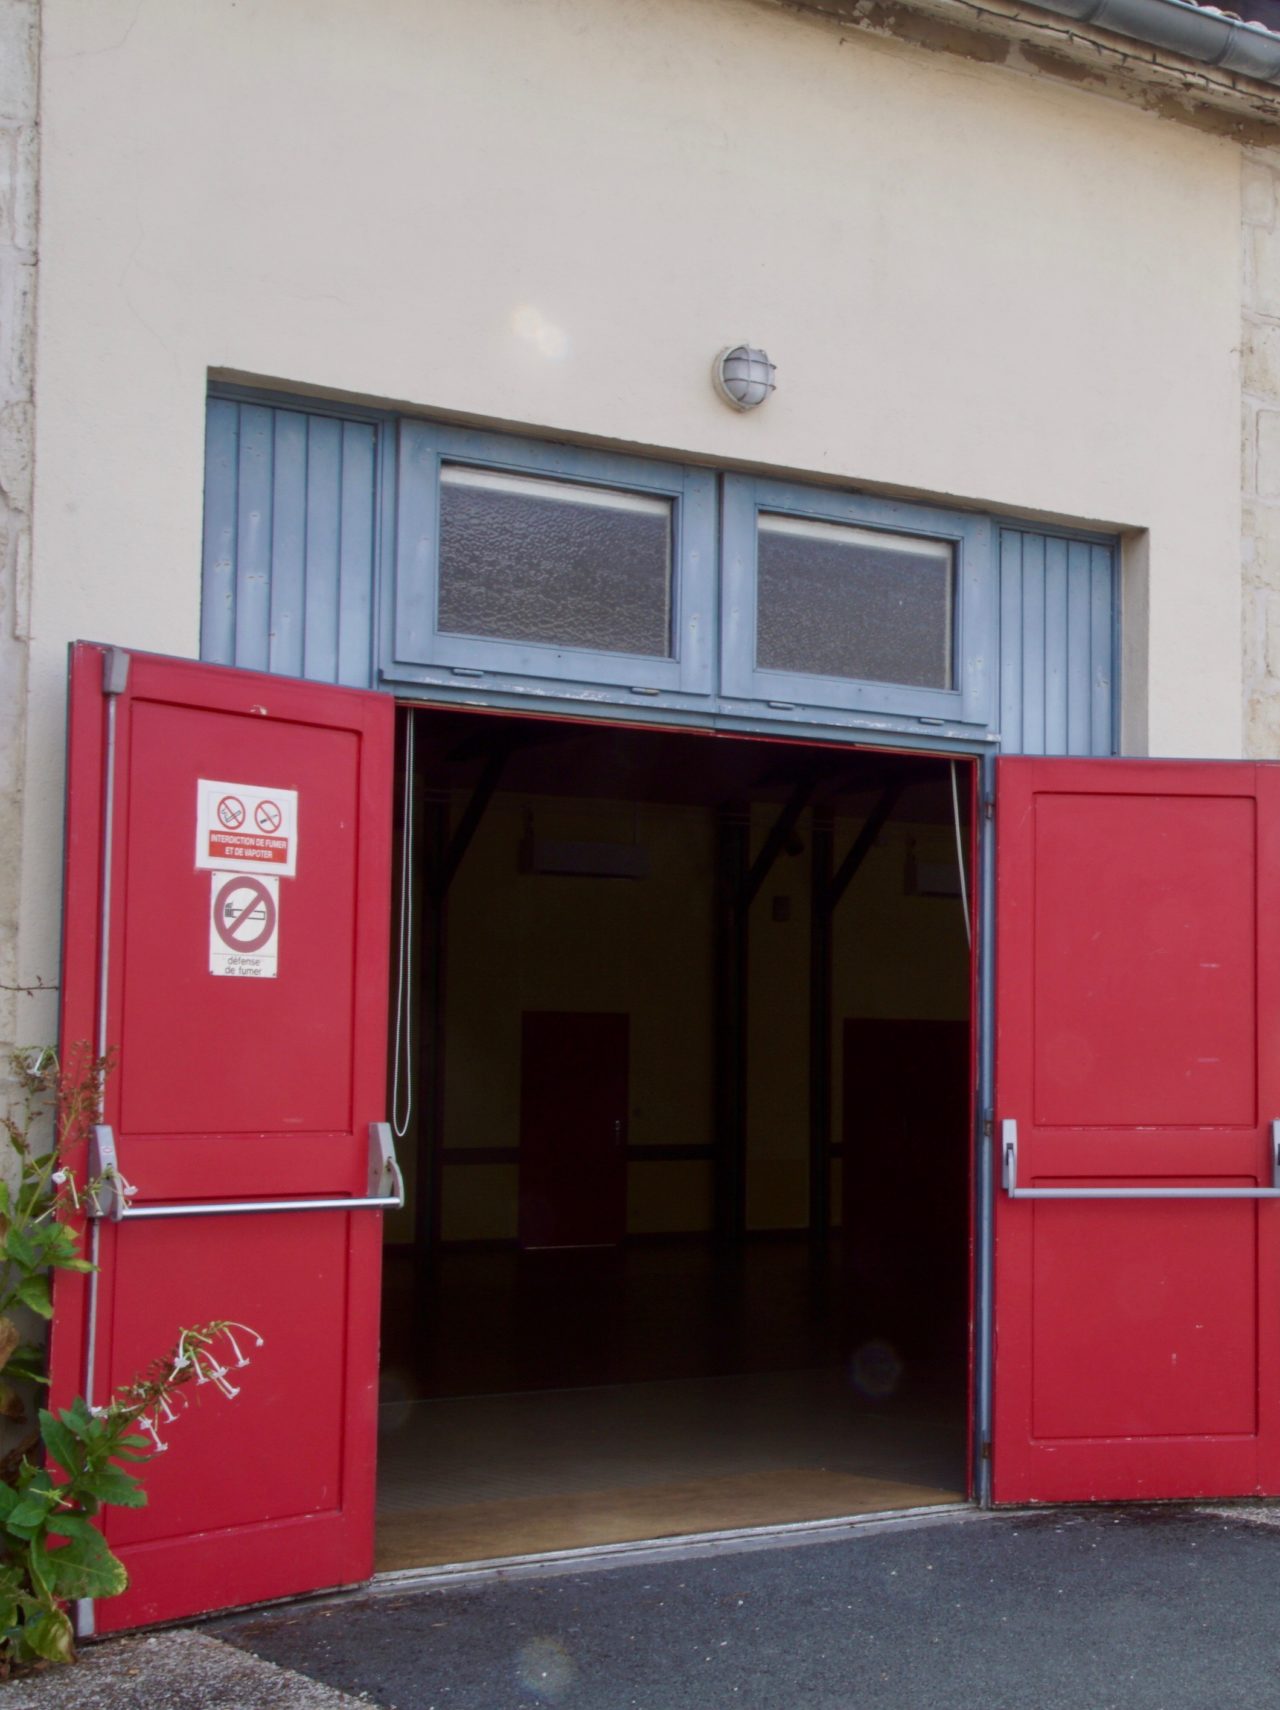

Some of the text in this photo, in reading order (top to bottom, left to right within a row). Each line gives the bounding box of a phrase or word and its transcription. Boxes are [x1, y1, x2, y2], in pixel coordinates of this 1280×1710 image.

[210, 834, 287, 849] INTERDICTION DE FUMER
[225, 847, 273, 859] ET DE VAPOTER
[225, 966, 262, 976] de fumer
